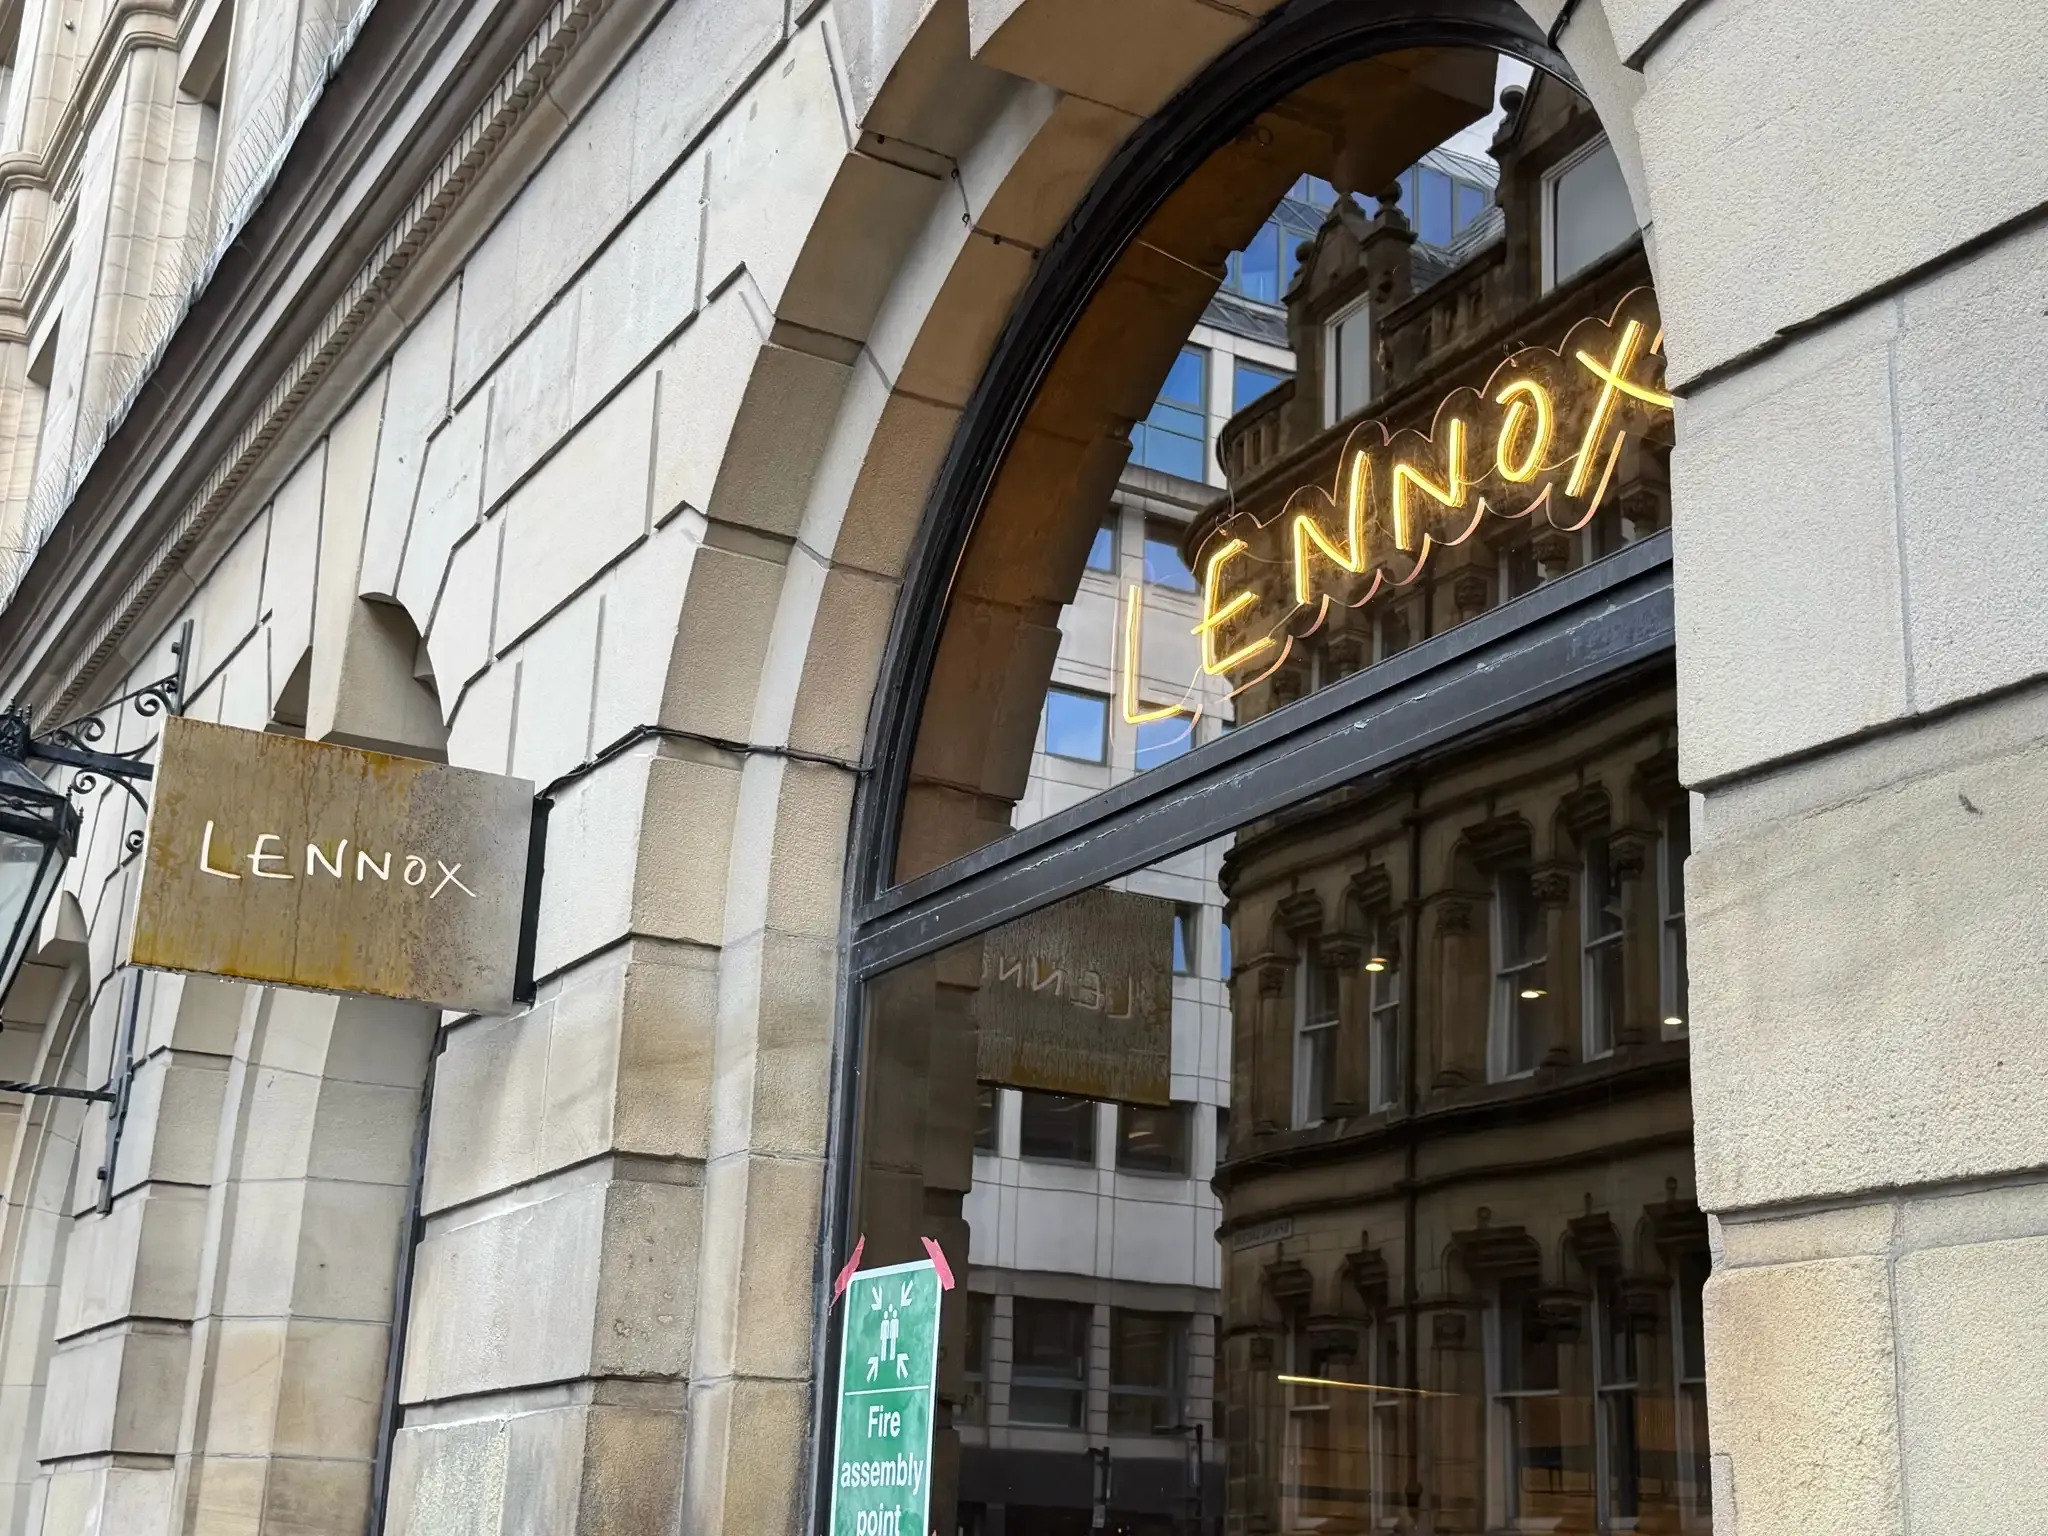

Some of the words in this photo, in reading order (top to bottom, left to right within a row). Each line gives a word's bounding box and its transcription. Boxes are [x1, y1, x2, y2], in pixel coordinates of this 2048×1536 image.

[1122, 319, 1674, 725] LENNOX
[200, 820, 477, 899] LENNOX
[867, 1404, 901, 1438] Fire
[840, 1452, 924, 1496] assembly
[856, 1502, 902, 1536] point
